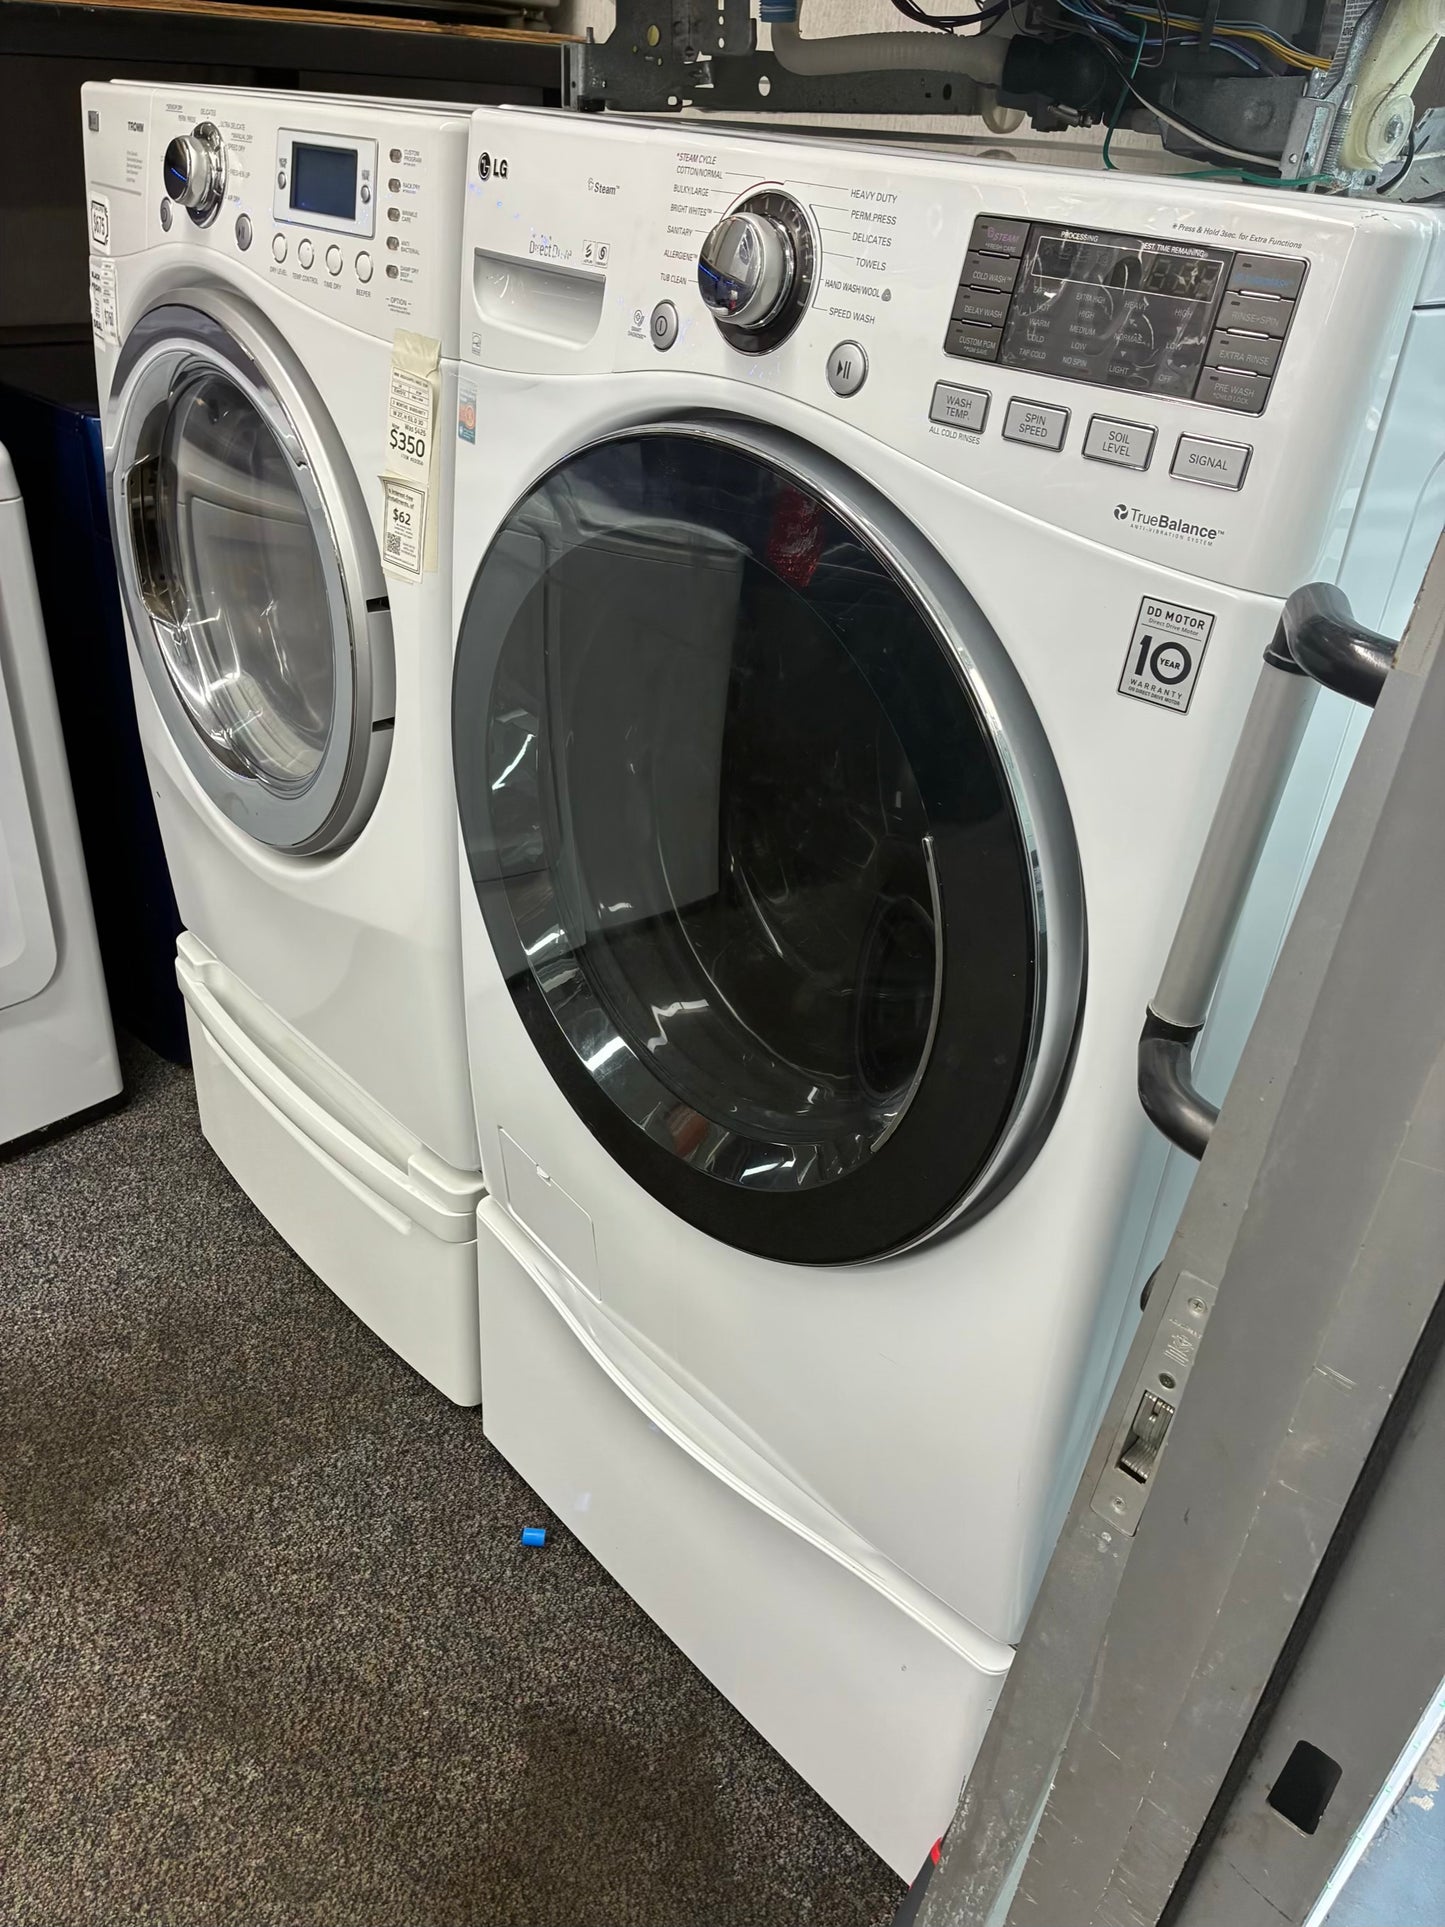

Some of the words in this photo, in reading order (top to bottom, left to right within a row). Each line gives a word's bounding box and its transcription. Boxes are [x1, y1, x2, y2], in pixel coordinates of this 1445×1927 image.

[699, 155, 717, 165] CYCLE
[493, 158, 508, 178] LG
[676, 165, 724, 180] COTTON/NORMAL
[673, 184, 710, 197] BULKY/LARGE
[851, 188, 877, 202] HEAVY
[878, 193, 898, 205] DUTY
[670, 203, 688, 214] BRIGHT
[667, 225, 693, 237] SANITARY
[994, 232, 1020, 243] STEAM
[1061, 230, 1099, 242] PROCESSING
[1178, 224, 1195, 233] Press
[1204, 228, 1220, 236] Hold
[1238, 232, 1249, 241] for
[1249, 234, 1268, 244] Extra
[1268, 237, 1302, 249] Functions
[852, 232, 892, 247] DELICATES
[1158, 244, 1171, 254] TIME
[1171, 246, 1205, 258] REMAINING
[855, 257, 887, 272] TOWELS
[660, 272, 671, 282] TUB
[672, 274, 687, 285] CLEAN
[972, 270, 988, 280] COLD
[356, 288, 371, 298] BEEPER
[824, 279, 842, 292] HAND
[842, 282, 880, 298] WASH/WOOL
[964, 305, 984, 315] DELAY
[984, 308, 1003, 318] WASH
[1124, 301, 1148, 311] HEAVY
[1175, 308, 1193, 318] HIGH
[829, 307, 852, 320] SPEED
[853, 311, 876, 324] WASH
[1078, 310, 1095, 319] HIGH
[1029, 318, 1050, 328] WARM
[1069, 325, 1096, 336] MEDIUM
[959, 335, 983, 347] CUSTOM
[983, 340, 996, 349] PGM
[1027, 334, 1044, 343] COLD
[1071, 342, 1087, 350] LOW
[1031, 350, 1046, 360] COLD
[1062, 356, 1072, 364] NO
[1072, 358, 1088, 368] SPIN
[1219, 350, 1244, 362] EXTRA
[1245, 355, 1271, 366] RINSE
[1109, 365, 1130, 375] LIGHT
[1214, 383, 1230, 393] PRE
[1230, 386, 1255, 398] WASH
[946, 394, 973, 410] WASH
[946, 407, 971, 421] TEMP.
[1025, 412, 1047, 426] SPIN
[928, 425, 941, 436] ALL
[941, 429, 958, 440] COLD
[959, 432, 981, 446] RINSES
[1018, 423, 1048, 438] SPEED
[390, 428, 425, 458] $350
[1108, 430, 1131, 446] SOIL
[1102, 442, 1132, 458] LEVEL
[1188, 453, 1228, 472] SIGNAL
[393, 508, 411, 526] $62
[1130, 524, 1184, 540] ANTI-VIBRATION
[1187, 536, 1213, 546] SYSTEM
[1147, 606, 1162, 618] DD
[1165, 610, 1206, 630] MOTOR
[1148, 618, 1165, 627] Direct
[1165, 622, 1180, 632] Drive
[1181, 626, 1199, 636] Motor
[1134, 634, 1192, 685] 10
[1160, 658, 1181, 670] YEAR
[1130, 678, 1182, 700] WARRANTY
[1135, 688, 1150, 697] DIRECT
[1150, 692, 1164, 701] DRIVE
[1164, 696, 1180, 706] MOTOR
